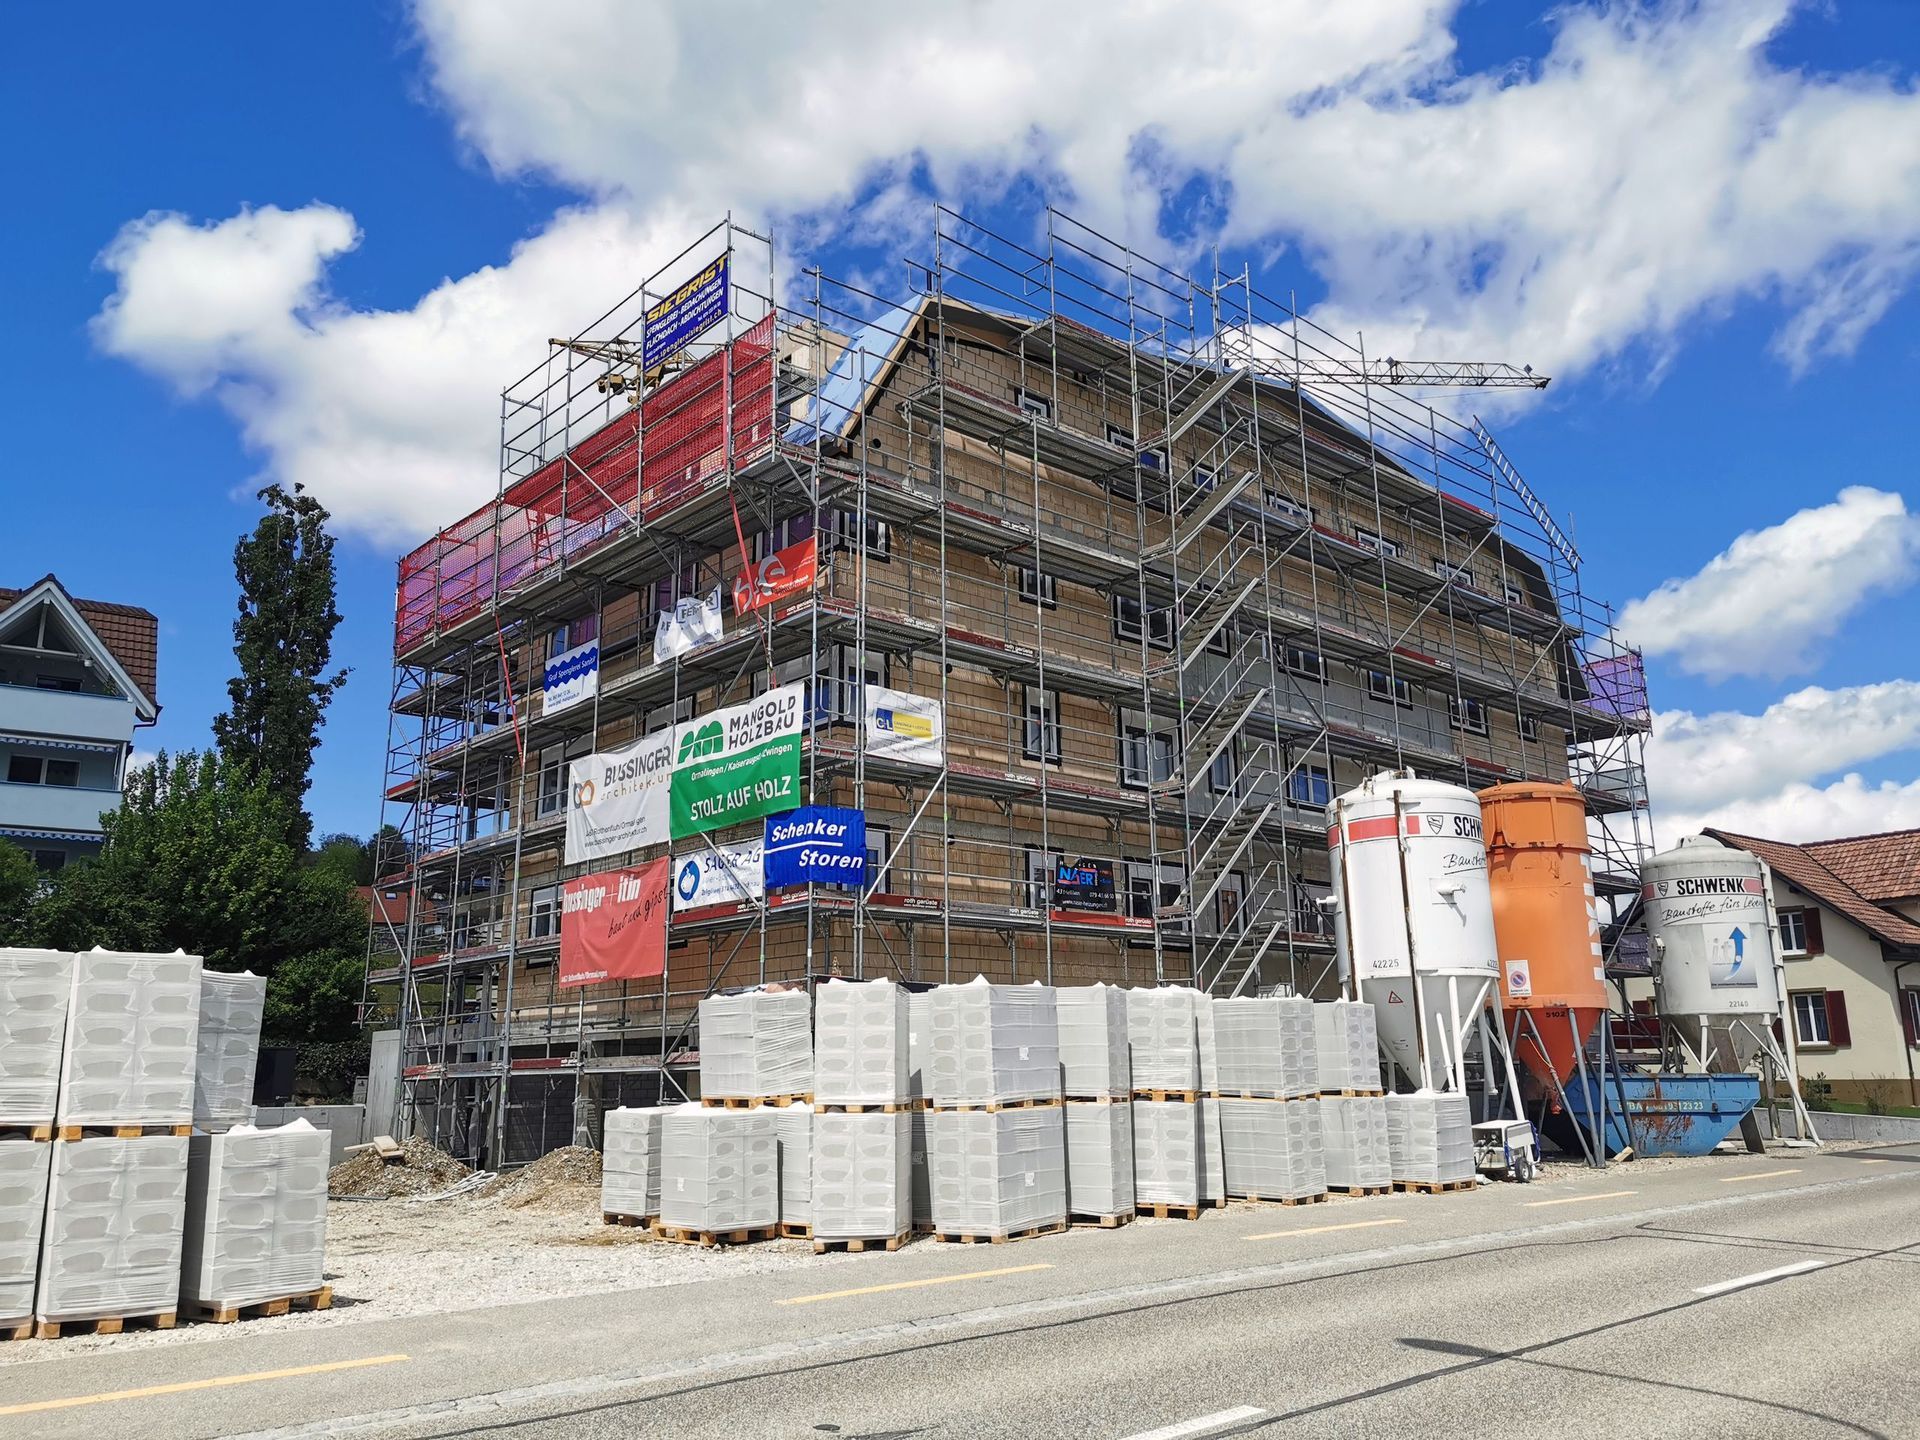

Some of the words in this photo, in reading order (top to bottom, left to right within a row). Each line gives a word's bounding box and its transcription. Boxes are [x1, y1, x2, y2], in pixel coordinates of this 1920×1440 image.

[647, 254, 728, 324] SIEGRIST
[646, 310, 679, 338] SPENGLEREI
[681, 276, 723, 314] BEDACHUNGEN
[646, 321, 678, 350] FLACHDACH
[680, 286, 724, 326] ABDICHTUNGEN
[729, 695, 796, 733] MANGOLD
[728, 712, 794, 750] HOLZBAU
[690, 794, 725, 821] STOLZ
[727, 786, 751, 811] AUF
[754, 775, 792, 801] HOLZ
[771, 818, 847, 842] Schenker
[744, 847, 761, 864] AG
[798, 848, 864, 869] Storen
[562, 884, 606, 914] bussinger
[617, 873, 642, 904] itin
[1676, 878, 1745, 895] SCHWENK
[916, 898, 938, 907] gerüste
[1020, 908, 1039, 918] gerüste
[1661, 901, 1716, 921] Baustoffe
[1719, 896, 1740, 914] fürs
[1373, 959, 1400, 969] 42225
